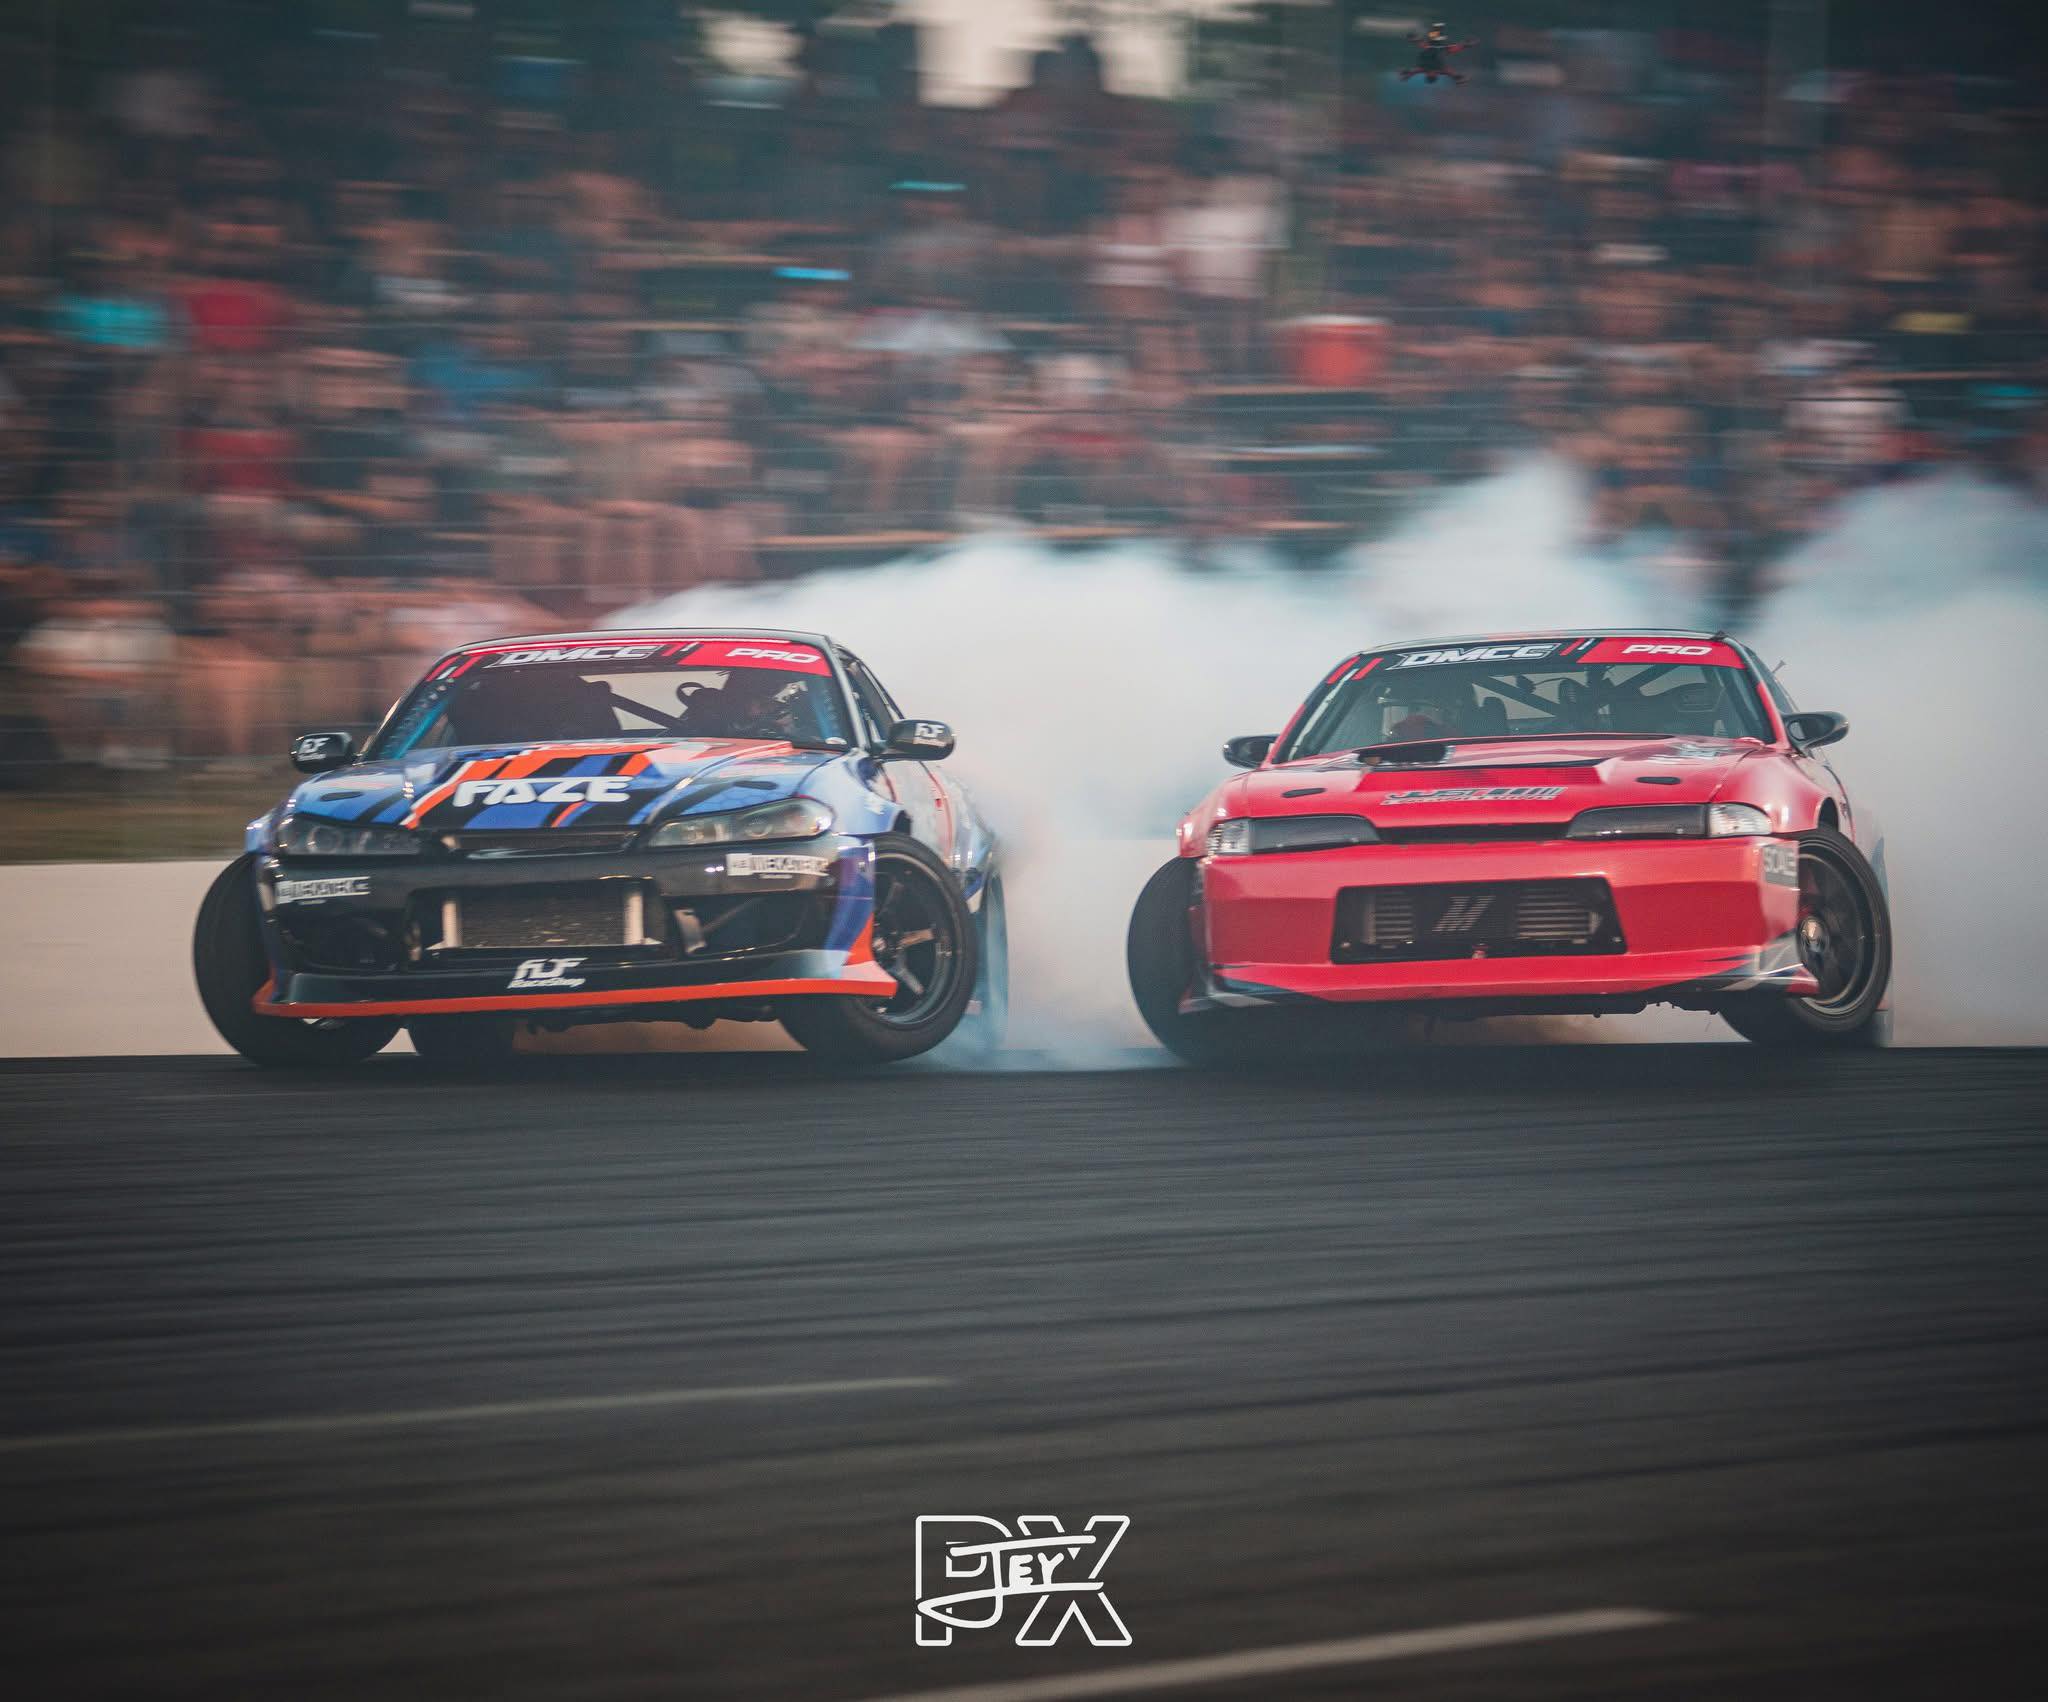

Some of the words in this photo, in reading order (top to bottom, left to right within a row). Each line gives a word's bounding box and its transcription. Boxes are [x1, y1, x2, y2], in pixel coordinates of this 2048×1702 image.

[499, 644, 659, 666] DMCC
[725, 647, 822, 664] PRO
[1399, 645, 1556, 667] DMCC
[1621, 644, 1713, 657] PRO
[452, 775, 633, 808] FAZE
